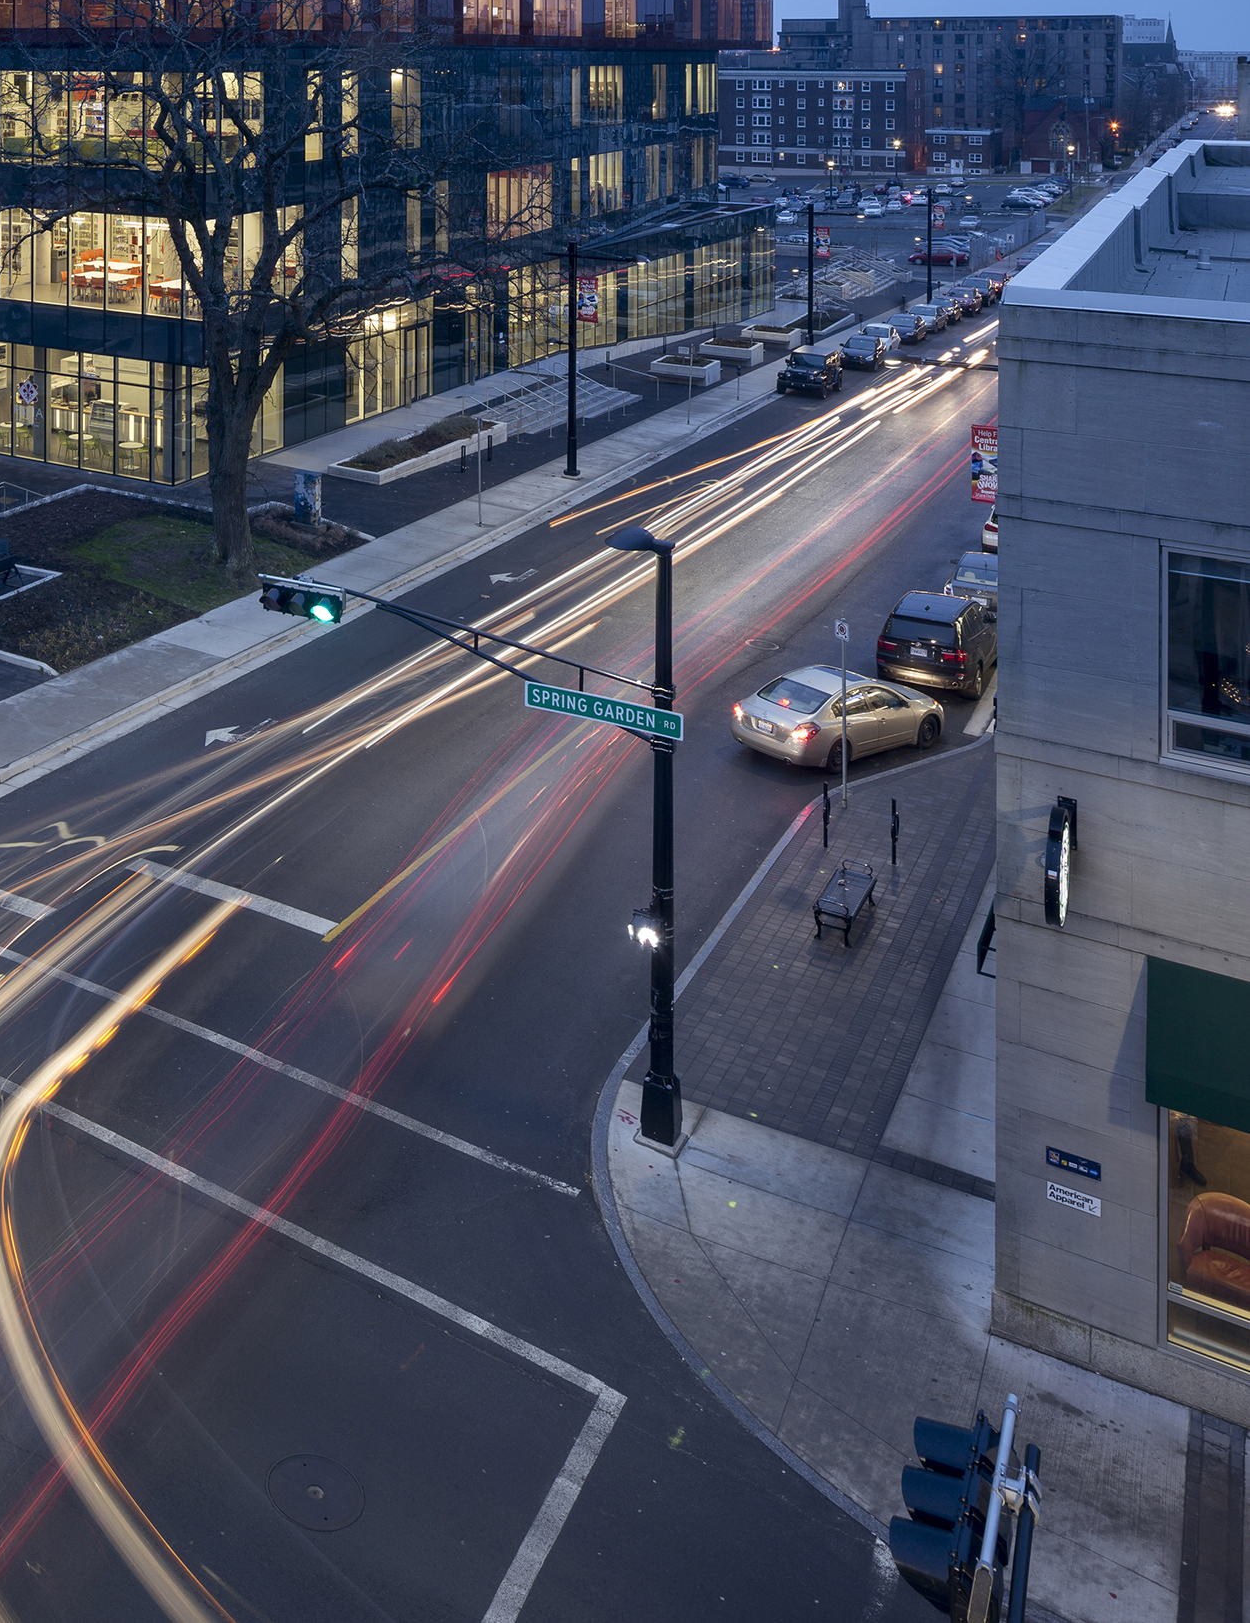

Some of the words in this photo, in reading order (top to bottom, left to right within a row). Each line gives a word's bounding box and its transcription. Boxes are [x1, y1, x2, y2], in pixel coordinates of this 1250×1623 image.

[974, 435, 998, 445] Centra
[978, 443, 998, 452] Libra
[979, 474, 998, 482] SHAR
[532, 688, 588, 713] SPRING
[593, 701, 656, 729] GARDEN
[663, 720, 676, 730] RD
[1048, 1183, 1094, 1205] American
[1048, 1191, 1085, 1209] Apparel
